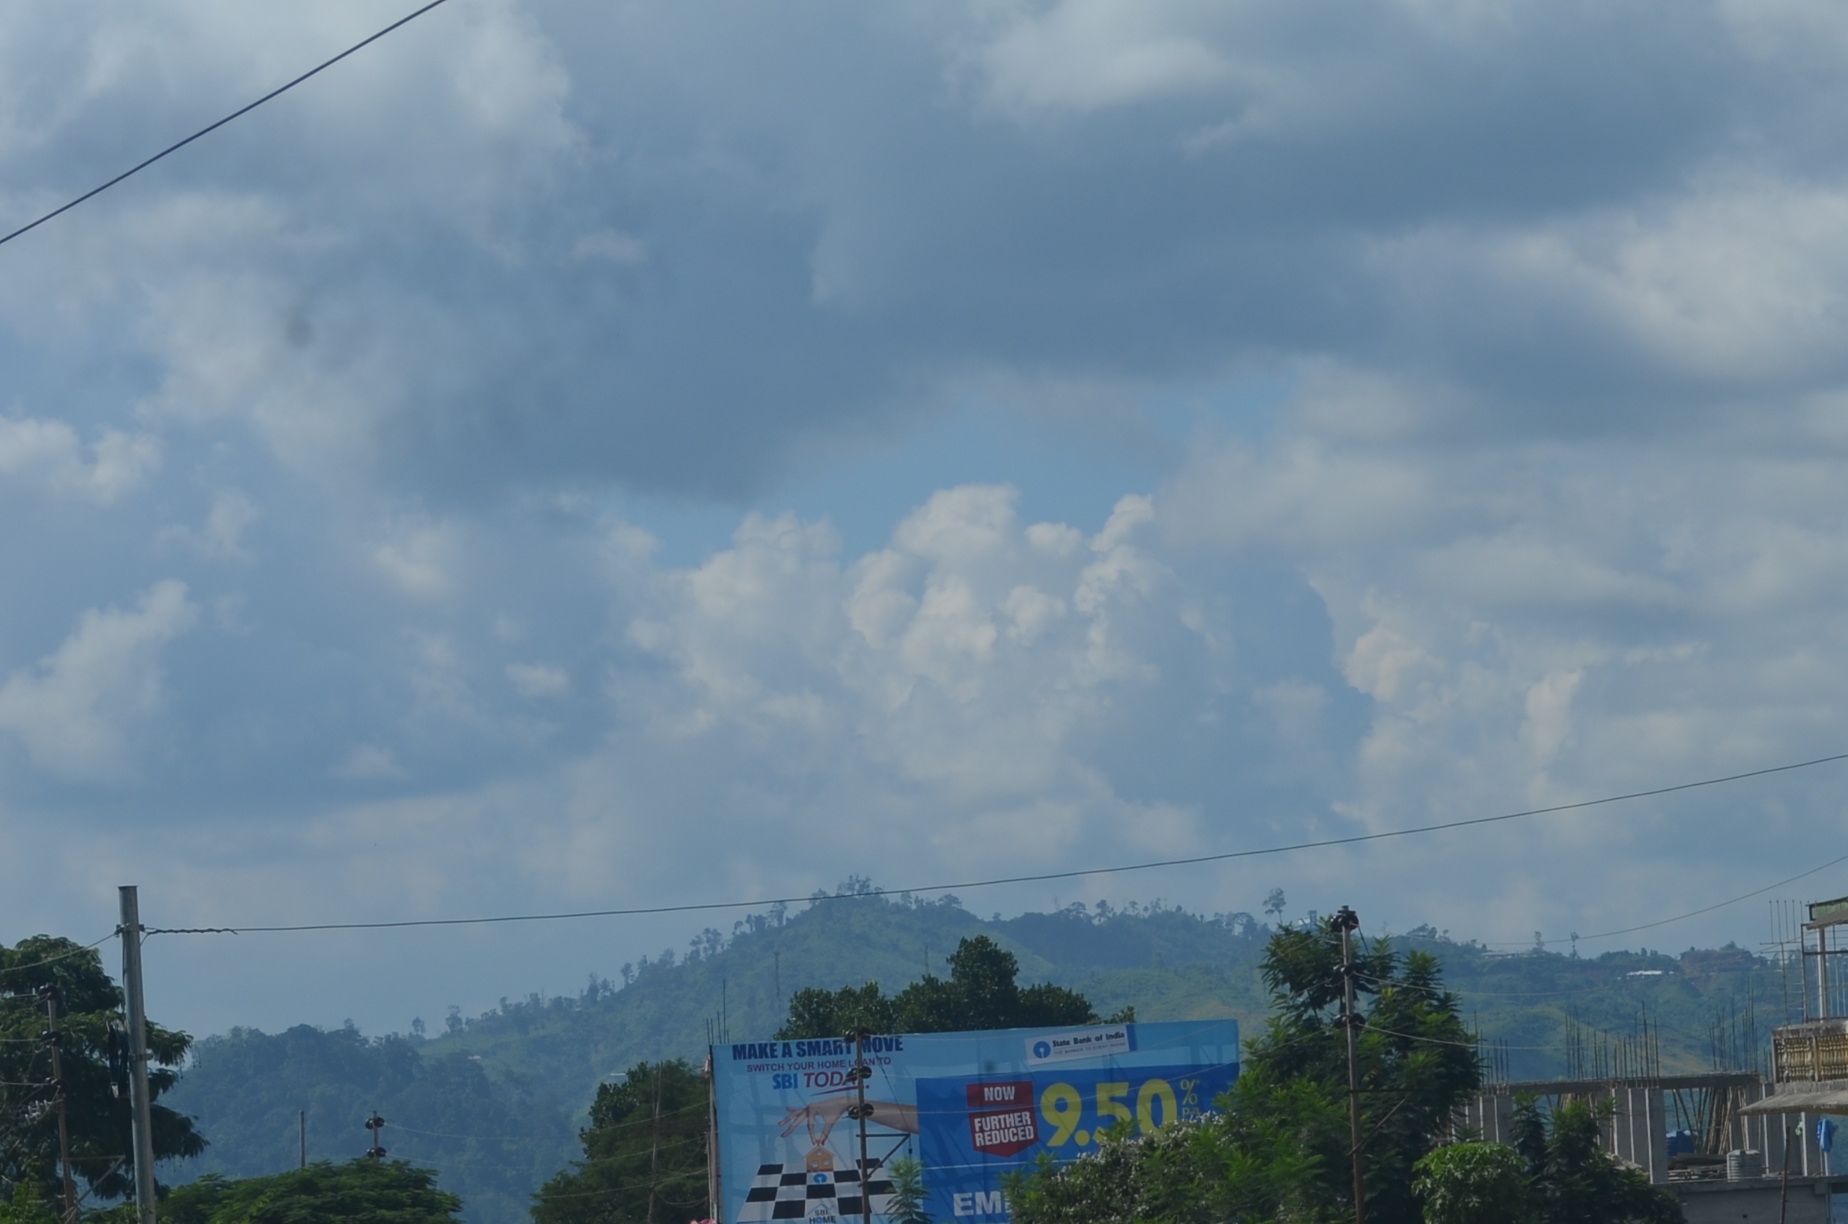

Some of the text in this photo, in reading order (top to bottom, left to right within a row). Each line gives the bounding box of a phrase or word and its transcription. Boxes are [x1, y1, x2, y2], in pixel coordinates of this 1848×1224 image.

[1073, 1036, 1091, 1045] Bank
[1095, 1034, 1103, 1042] of
[1106, 1032, 1125, 1040] India
[733, 1036, 904, 1060] MAKE A SMART MOVE
[747, 1063, 784, 1072] SWITCH
[786, 1062, 815, 1071] YOUR
[817, 1060, 846, 1069] HOME
[877, 1057, 891, 1065] TO
[772, 1073, 798, 1090] SBI
[984, 1086, 1015, 1102] NOW
[974, 1111, 1031, 1131] FURTHER
[1040, 1078, 1178, 1147] 9.50
[975, 1126, 1035, 1147] REDUCED
[809, 1216, 837, 1224] HOME
